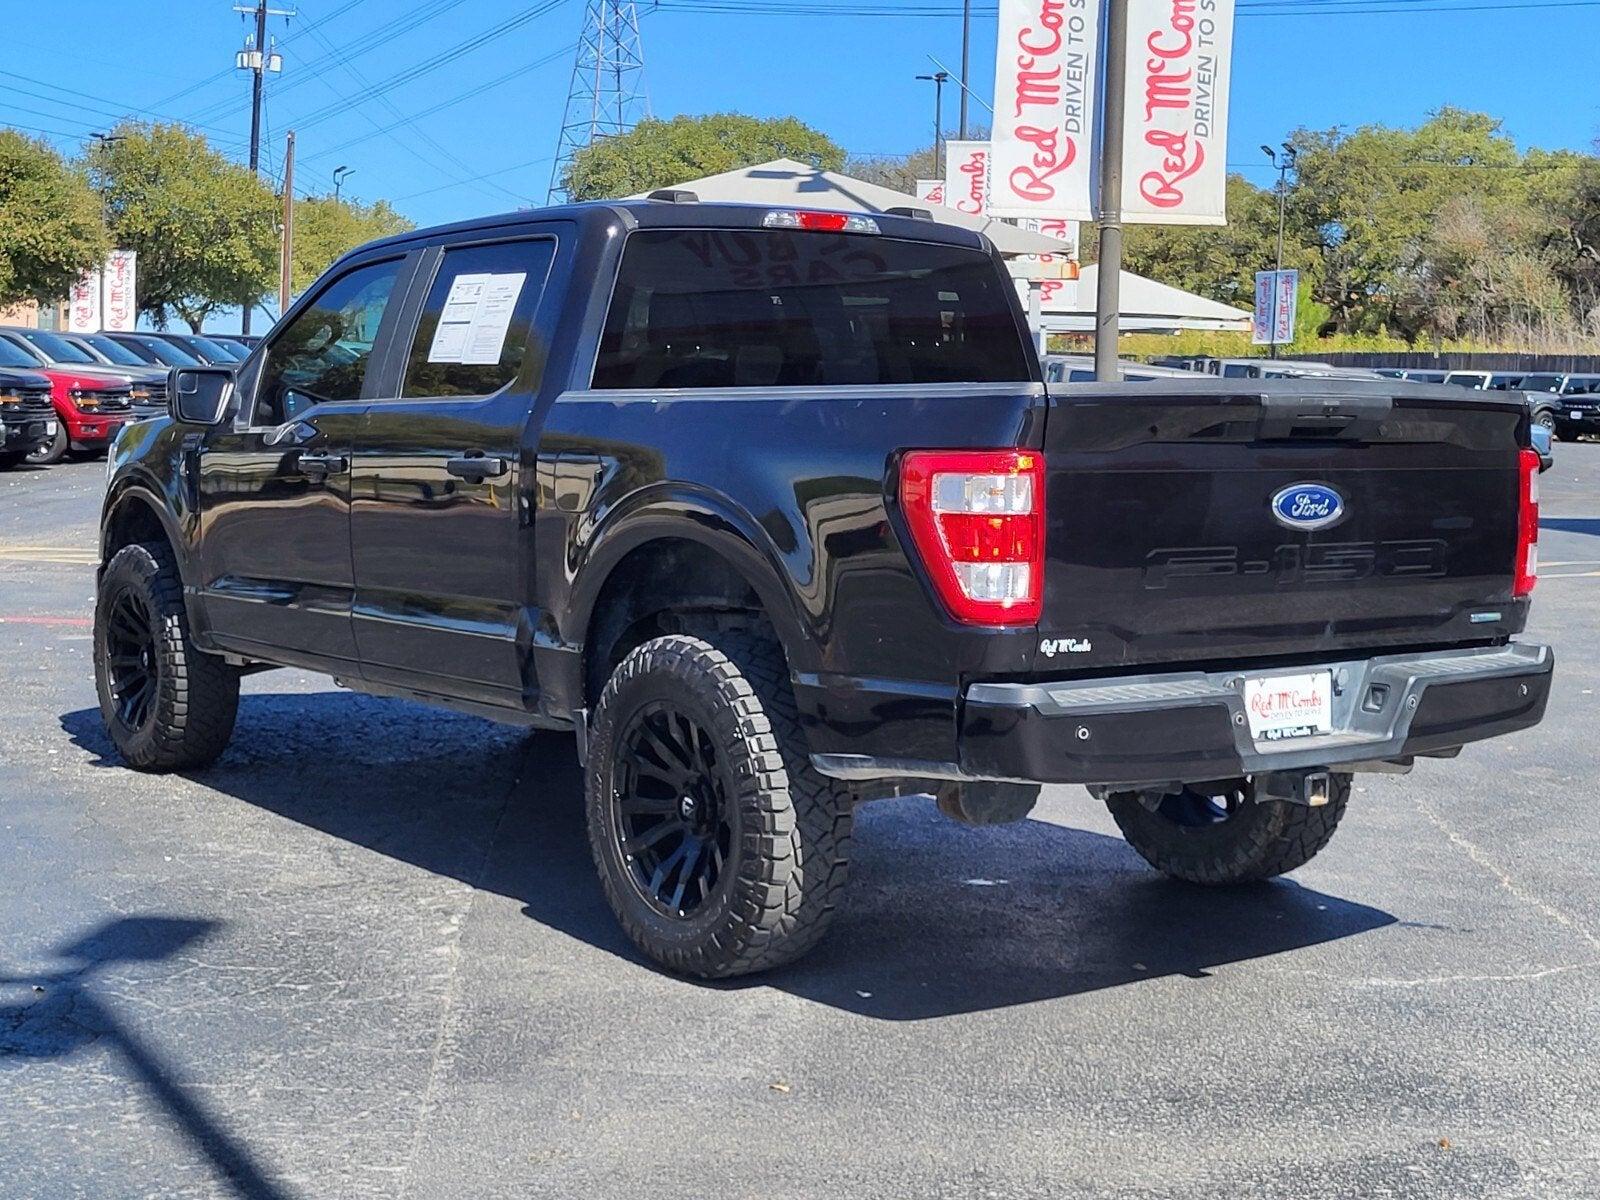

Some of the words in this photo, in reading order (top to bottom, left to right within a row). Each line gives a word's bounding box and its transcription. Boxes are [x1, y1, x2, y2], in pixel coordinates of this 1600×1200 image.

[1068, 16, 1085, 45] TO
[1199, 18, 1215, 47] TO
[1065, 53, 1084, 133] DRIVEN
[1194, 56, 1212, 138] DRIVEN
[1009, 126, 1076, 201] Red
[1139, 130, 1204, 208] Red
[1292, 493, 1329, 517] Ford
[1251, 693, 1272, 718] Red
